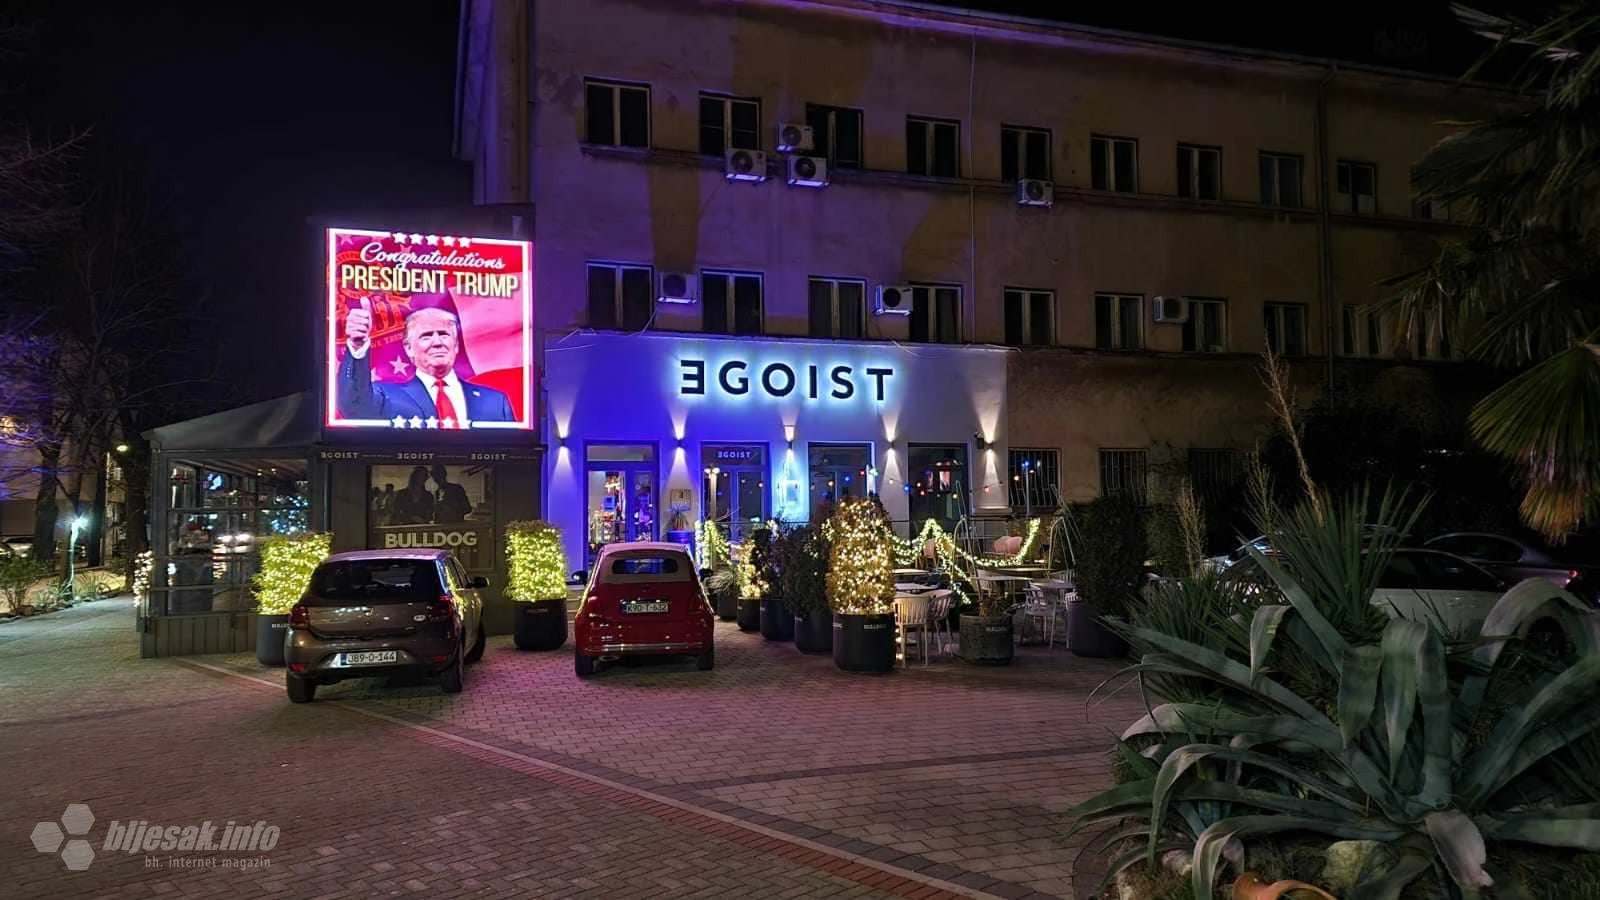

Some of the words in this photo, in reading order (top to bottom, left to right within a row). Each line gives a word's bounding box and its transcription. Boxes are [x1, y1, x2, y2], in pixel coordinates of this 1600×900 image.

[360, 241, 505, 272] Congratulations
[341, 265, 448, 294] PRESIDENT
[453, 271, 519, 298] TRUMP
[385, 532, 477, 548] BULLDOG
